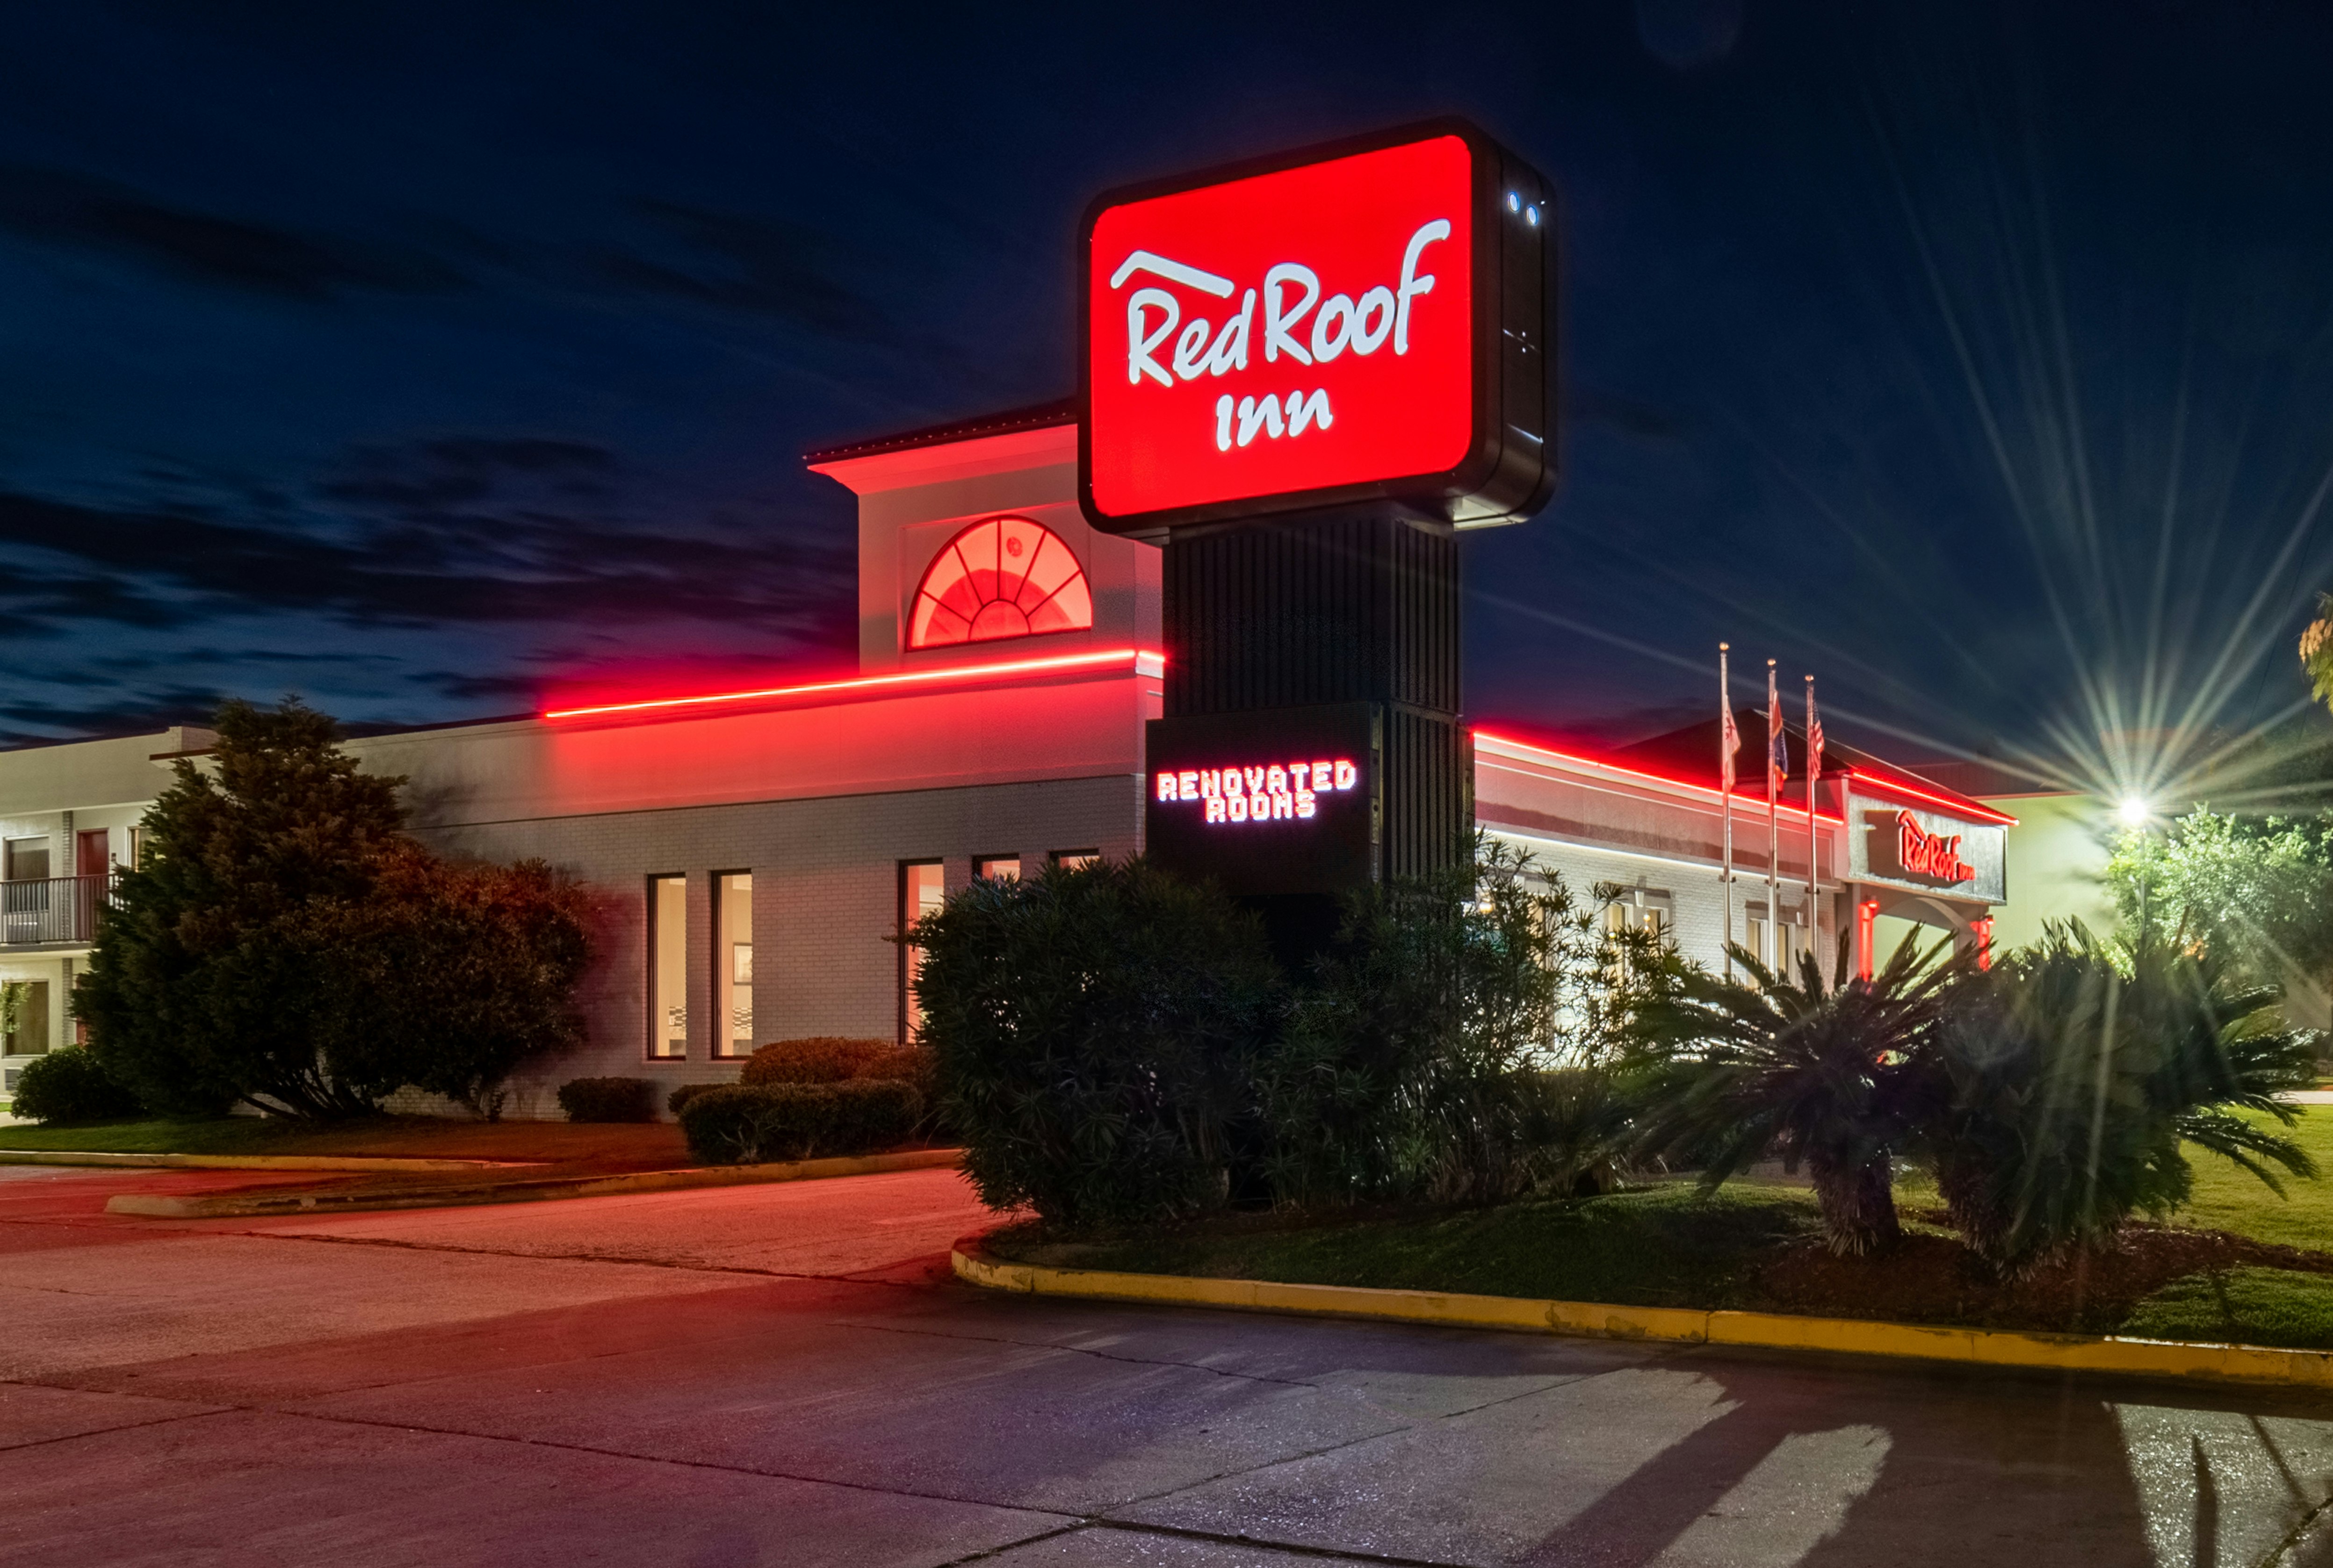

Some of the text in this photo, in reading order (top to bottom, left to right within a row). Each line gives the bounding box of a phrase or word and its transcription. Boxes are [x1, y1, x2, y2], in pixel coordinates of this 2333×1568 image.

[1127, 219, 1451, 388] Red Roof
[1157, 760, 1357, 801] RENOVATED
[1205, 789, 1316, 823] ROOMS
[1901, 826, 1930, 873] Red
[1929, 834, 1961, 881] Roof
